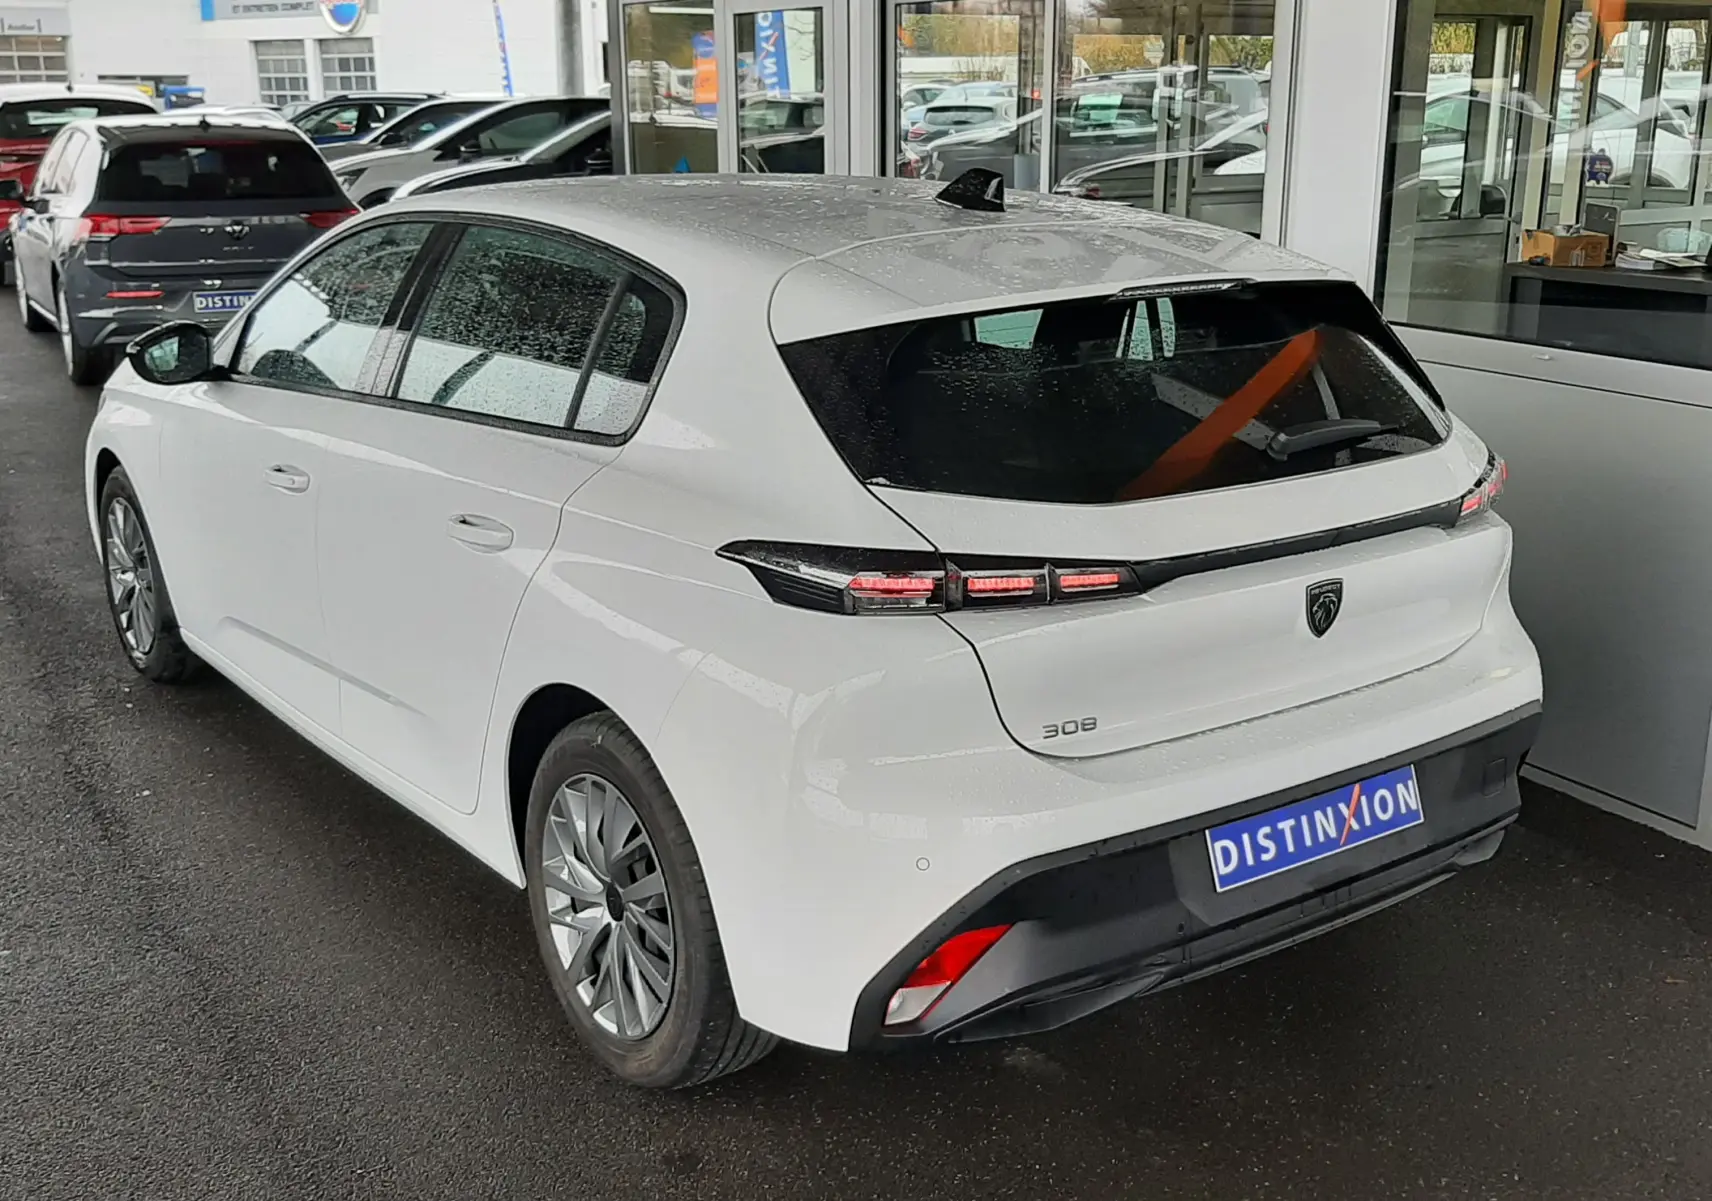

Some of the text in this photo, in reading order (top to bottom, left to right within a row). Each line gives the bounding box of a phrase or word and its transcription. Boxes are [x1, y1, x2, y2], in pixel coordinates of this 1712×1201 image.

[195, 295, 252, 309] DISTIN
[1042, 716, 1098, 740] 308
[1213, 779, 1419, 876] DISTINXION
